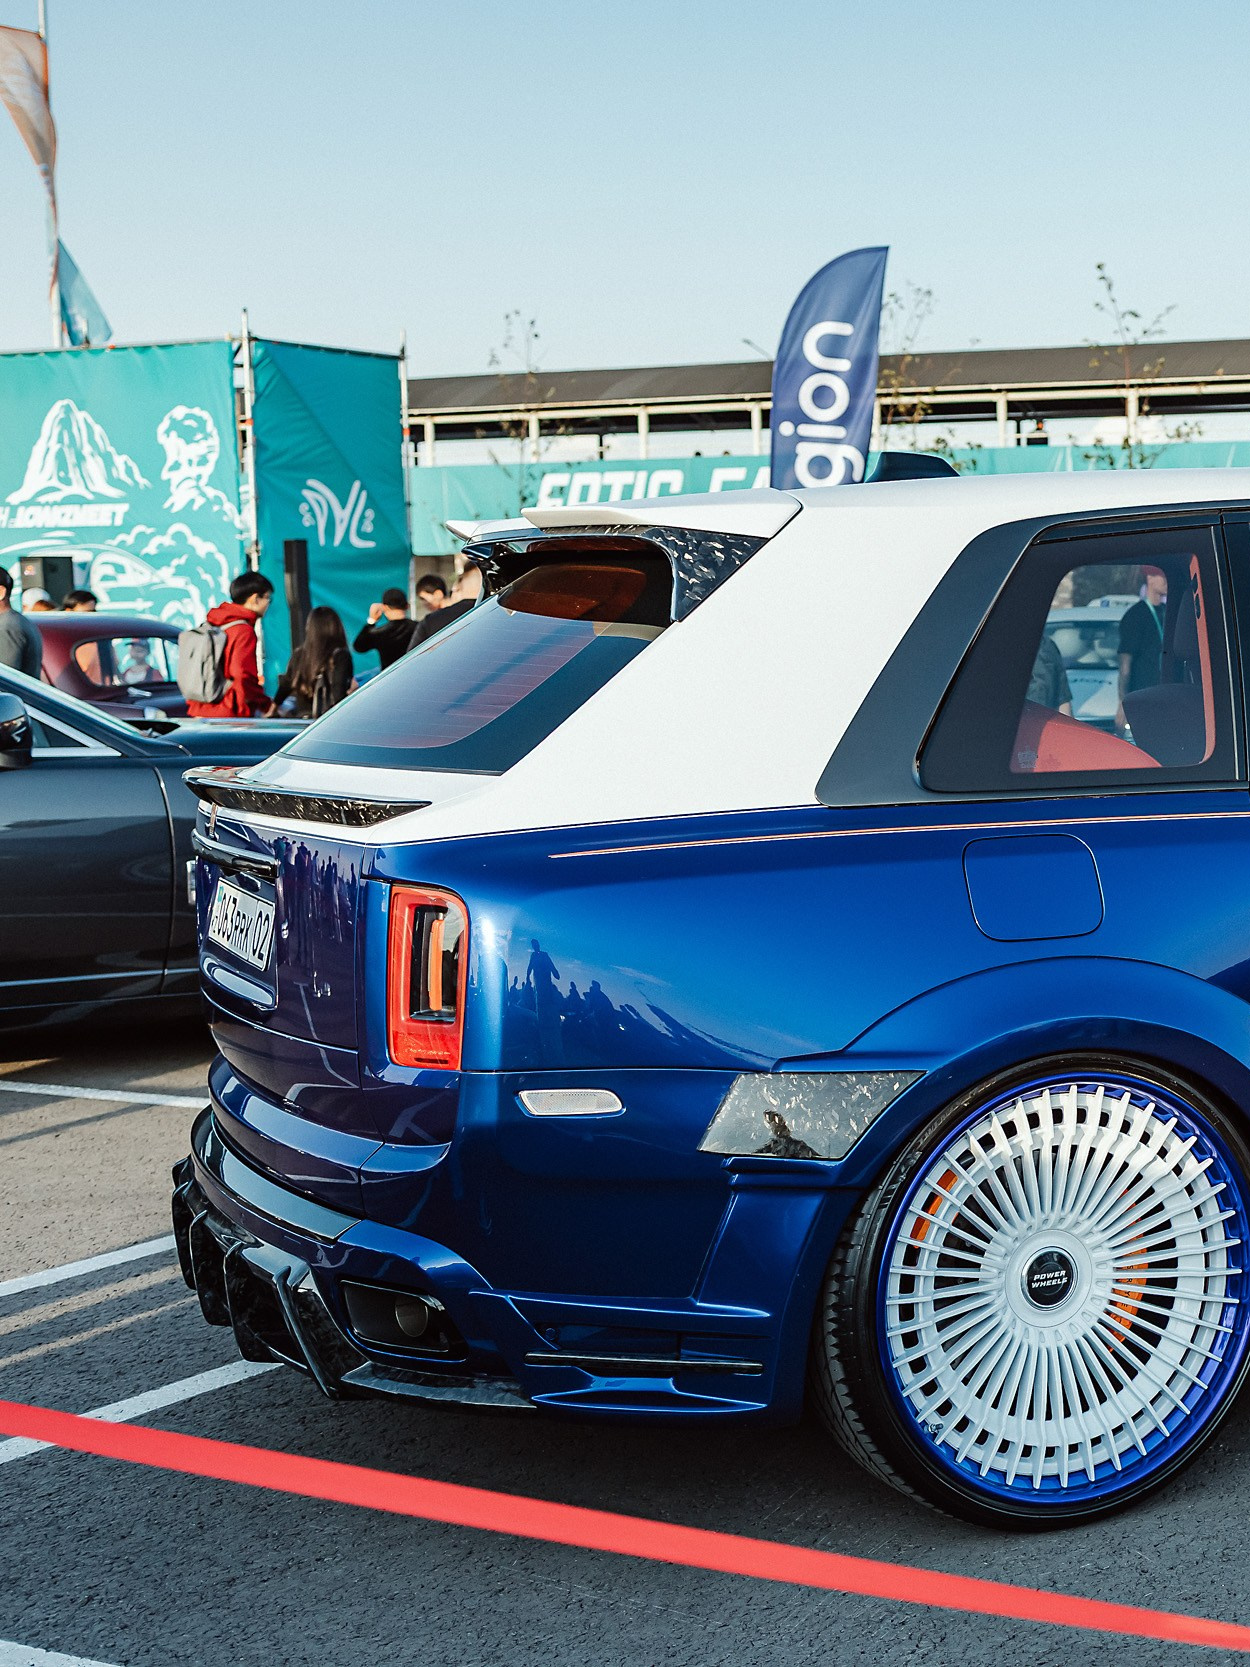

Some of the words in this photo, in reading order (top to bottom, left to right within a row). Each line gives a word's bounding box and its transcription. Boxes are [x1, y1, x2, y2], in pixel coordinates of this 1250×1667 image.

[252, 910, 270, 962] 02
[1033, 1270, 1067, 1281] POWER
[1031, 1277, 1069, 1289] WHEELS
